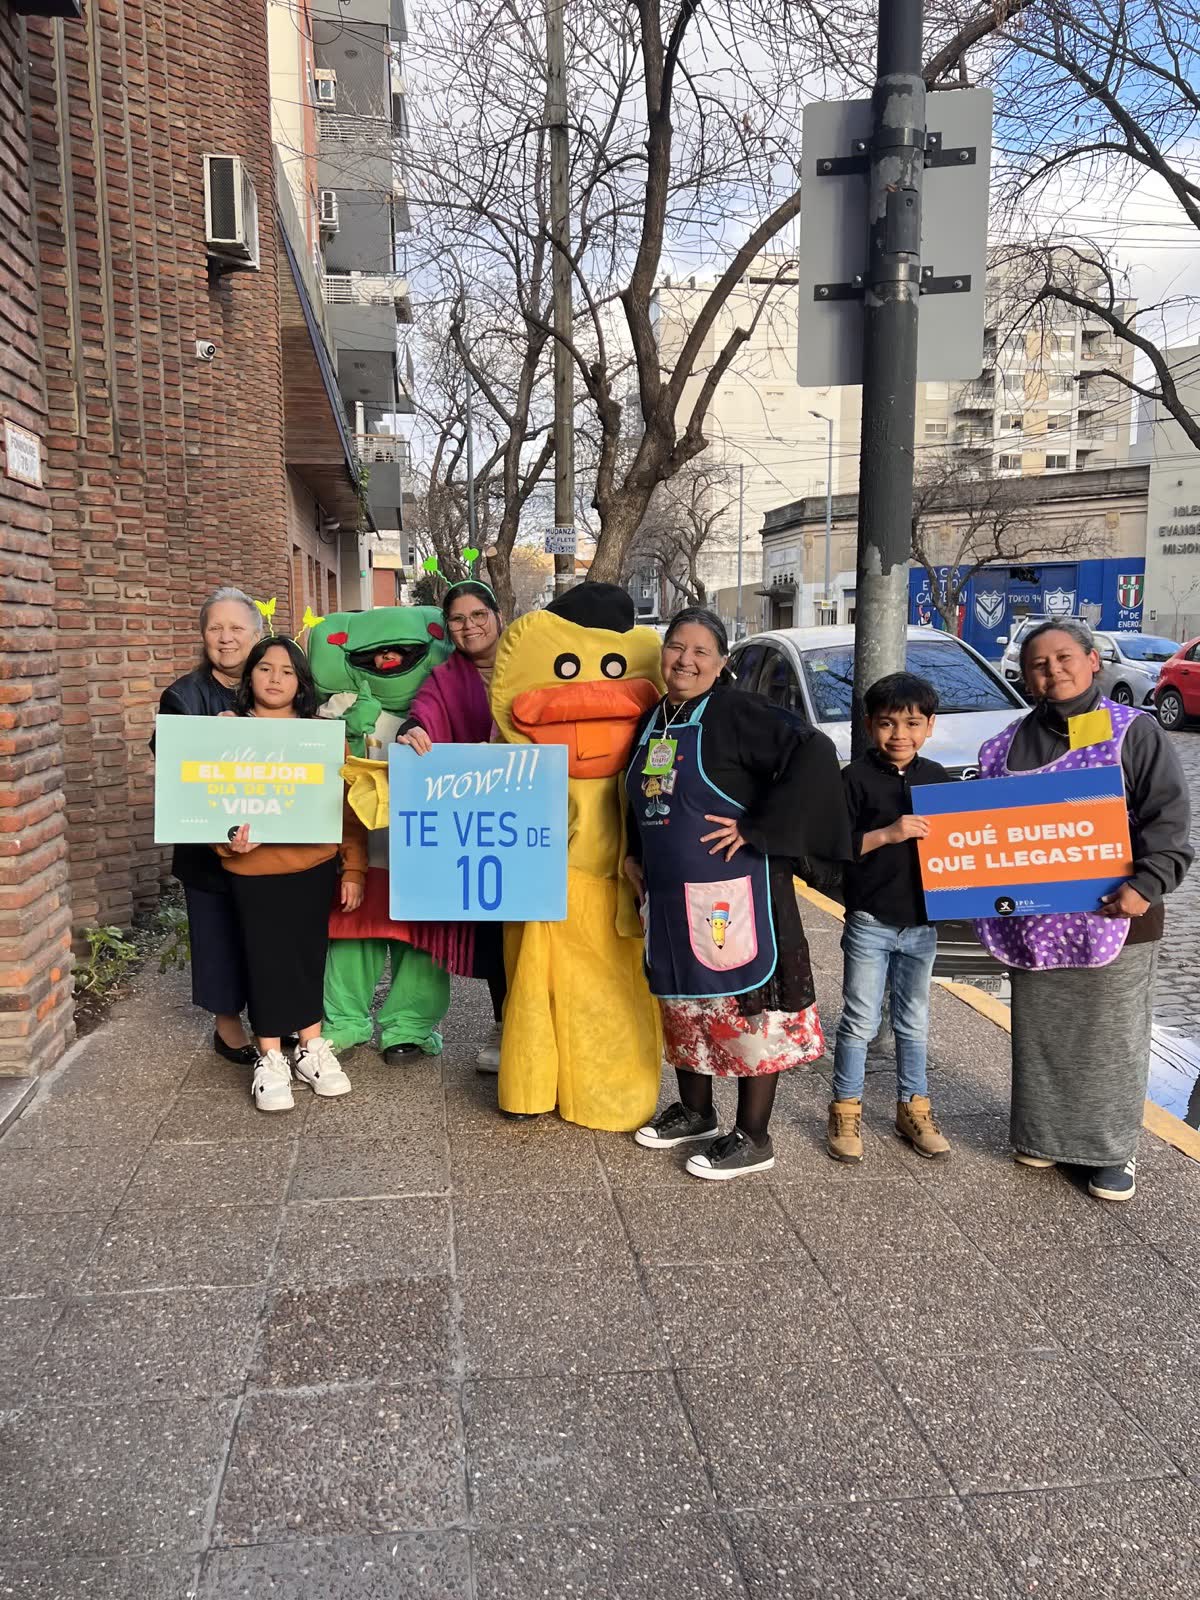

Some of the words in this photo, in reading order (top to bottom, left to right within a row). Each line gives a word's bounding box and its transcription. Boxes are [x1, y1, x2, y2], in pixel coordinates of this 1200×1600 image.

[1008, 594, 1030, 603] TOKIO
[1032, 594, 1042, 603] 94
[198, 764, 224, 779] EL
[234, 765, 307, 780] MEJOR
[244, 784, 266, 796] DE
[272, 784, 296, 796] TU
[222, 798, 281, 815] VIDA
[399, 811, 438, 847] TE
[453, 811, 518, 848] VES
[527, 827, 551, 848] DE
[948, 824, 998, 849] QUÉ
[1007, 820, 1095, 843] BUENO
[927, 855, 976, 874] QUE
[986, 842, 1124, 869] LLEGASTE!
[456, 855, 503, 911] 10
